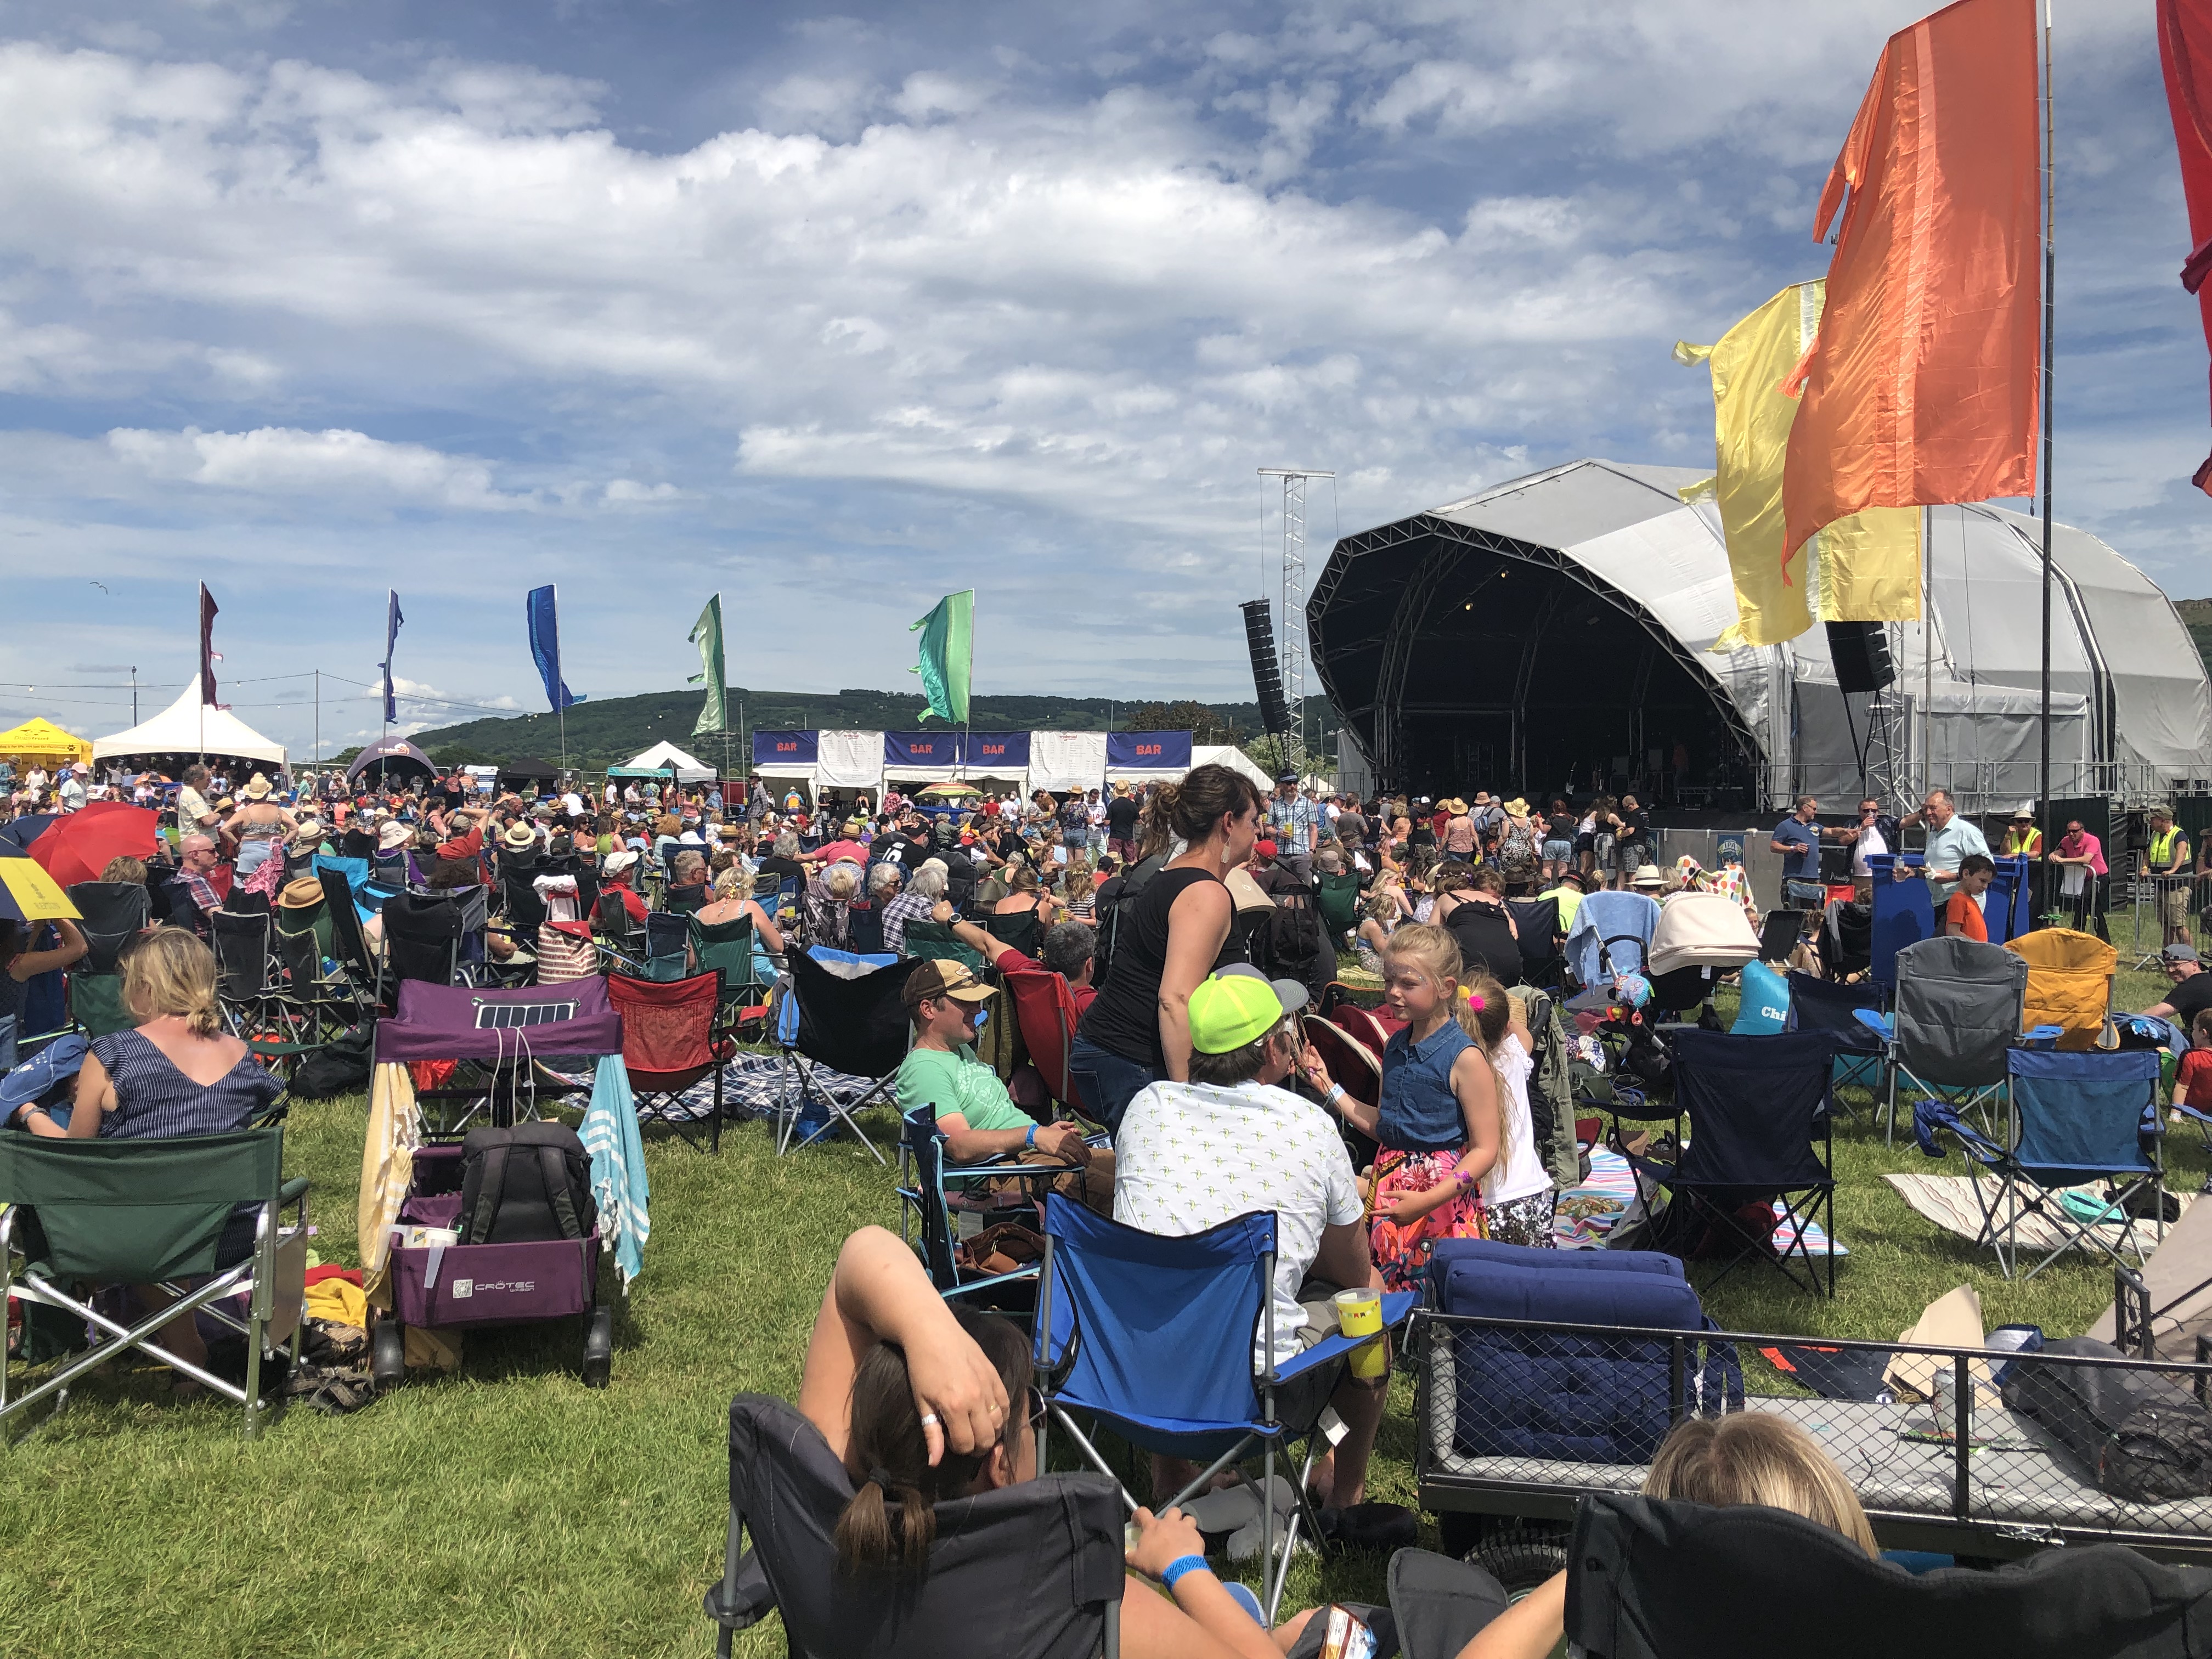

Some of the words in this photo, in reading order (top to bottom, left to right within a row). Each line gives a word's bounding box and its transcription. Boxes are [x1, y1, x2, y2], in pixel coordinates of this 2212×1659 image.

[777, 742, 797, 752] BAR
[910, 744, 933, 754] BAR
[983, 744, 1005, 754] BAR
[1136, 744, 1161, 755] BAR
